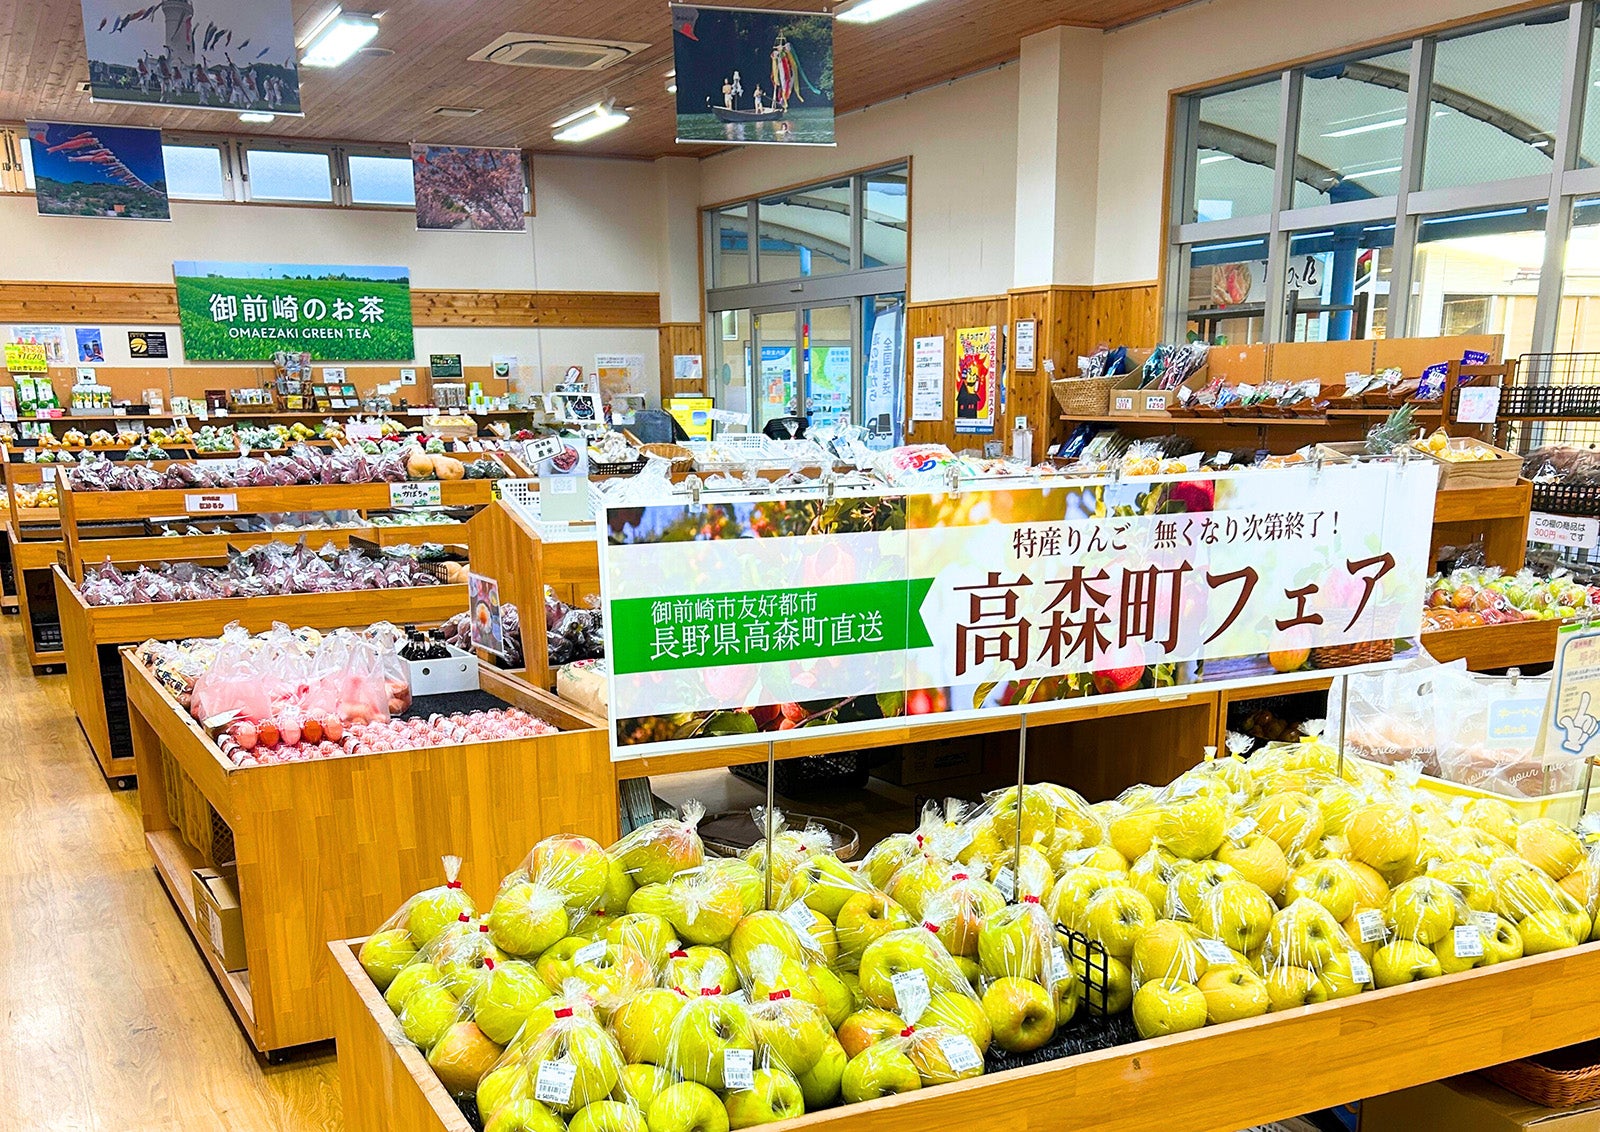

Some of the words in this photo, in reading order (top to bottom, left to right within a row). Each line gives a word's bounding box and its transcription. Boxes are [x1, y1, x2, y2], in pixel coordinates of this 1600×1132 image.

[209, 294, 385, 324] 御前崎のお茶
[229, 328, 299, 339] OMAEZAKI
[302, 328, 344, 339] GREEN
[348, 329, 372, 339] TEA
[1013, 523, 1131, 560] 特産りんご
[1153, 510, 1339, 550] 無くなり次第終了！
[651, 590, 818, 625] 御前崎市友好都市
[953, 552, 1396, 676] 高森町フェア
[650, 610, 884, 662] 長野県高森町直送
[1508, 768, 1540, 787] your
